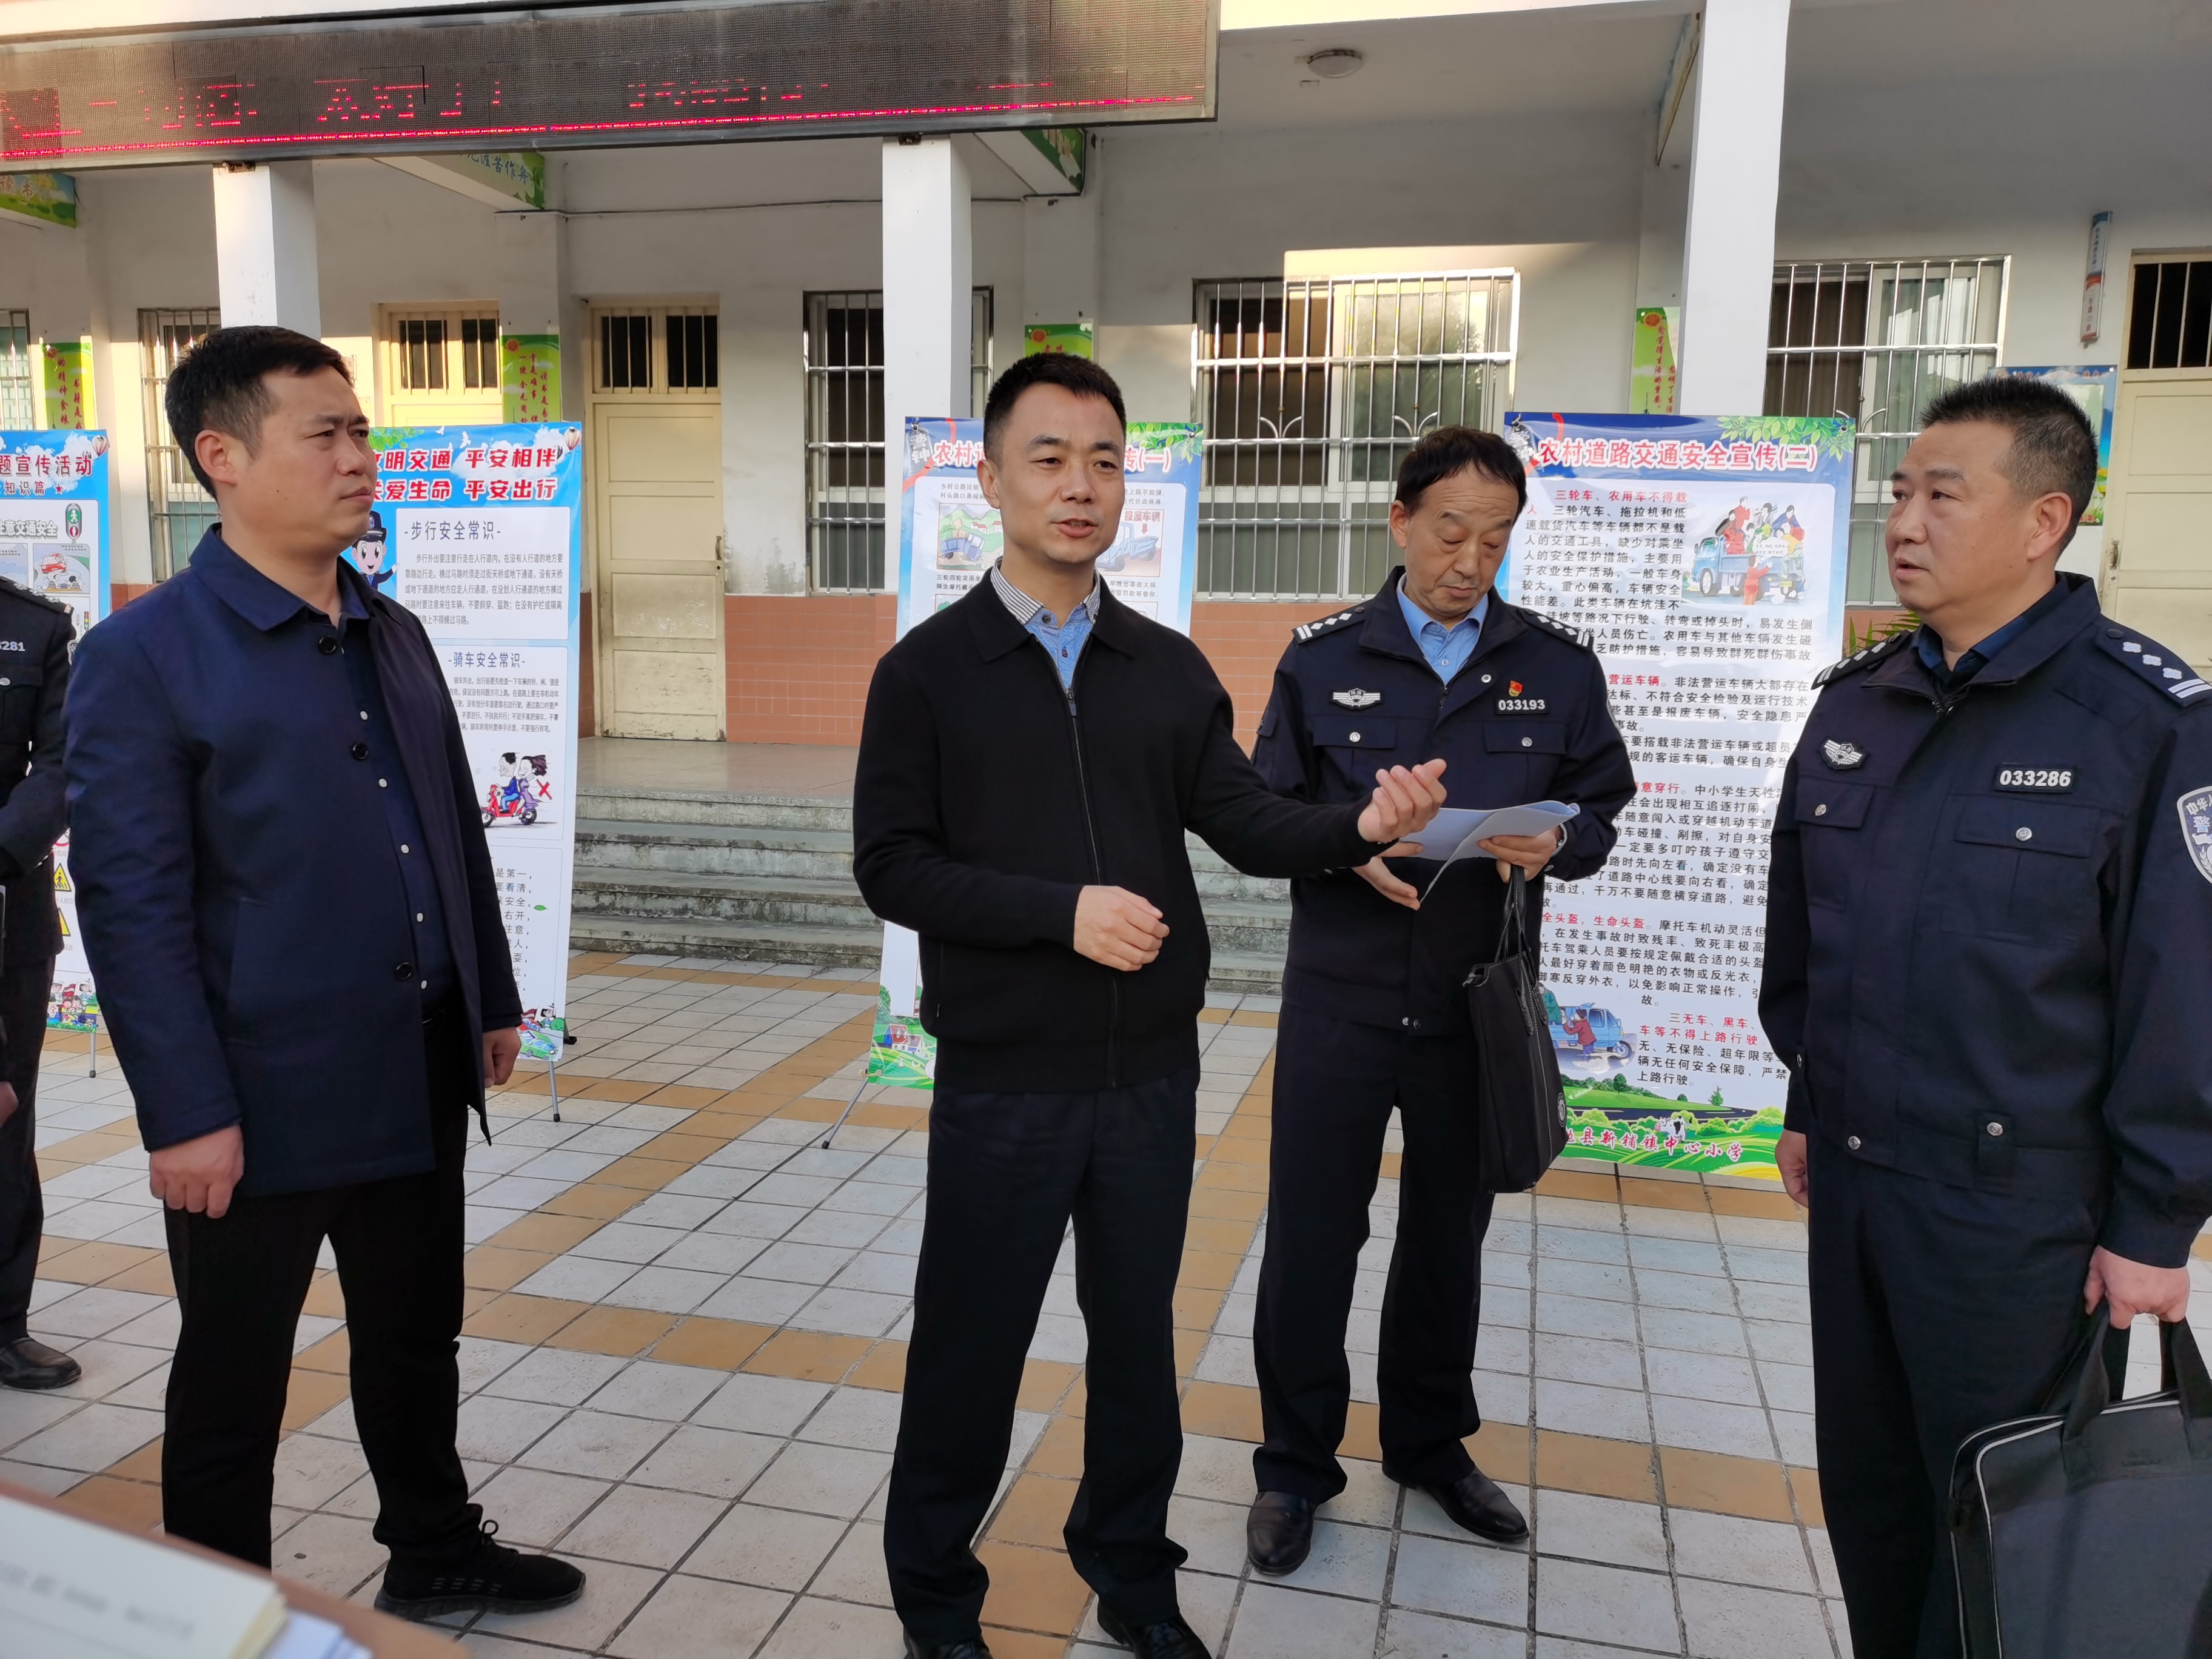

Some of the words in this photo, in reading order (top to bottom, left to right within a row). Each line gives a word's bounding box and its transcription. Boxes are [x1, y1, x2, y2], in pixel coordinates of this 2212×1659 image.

[0, 455, 92, 476] 题宣传活动
[464, 448, 557, 470] 平安相伴
[5, 481, 45, 495] 知识篇
[464, 477, 557, 500] 平安出行
[1555, 489, 1687, 503] 三轮车、农用车不得载
[1124, 511, 1161, 522] 报废车辆
[0, 520, 59, 538] 意交通安全
[1525, 519, 1685, 534] 速载货汽车等车辆都不是载
[1524, 534, 1684, 549] 人的交通工具，缺少对乘坐
[1524, 549, 1683, 565] 人的安全保护措施，主要用
[1523, 565, 1682, 581] 于农业生产活动，一般车身
[1522, 579, 1681, 595] 较大，重心偏高，车辆安全
[1521, 594, 1680, 611] 性能差。此类车辆在坑洼不
[418, 614, 469, 625] 路上不得横过马路。
[1498, 699, 1546, 711] 033193
[1623, 735, 1797, 753] 要搭载非法营运车辆或超员
[2000, 769, 2073, 788] 033286
[1627, 797, 1779, 814] 往会出现相互追逐打闹，
[1585, 870, 1768, 891] 了道路中心线要向右看，确定
[1540, 928, 1764, 953] ，在发生事故时致残率、致死率极高
[1641, 995, 1660, 1007] 故。
[1638, 1041, 1783, 1063] 无、无保险、超年限等
[1637, 1055, 1788, 1079] 辆无任何安全保障，严禁
[1637, 1071, 1695, 1087] 上路行驶。
